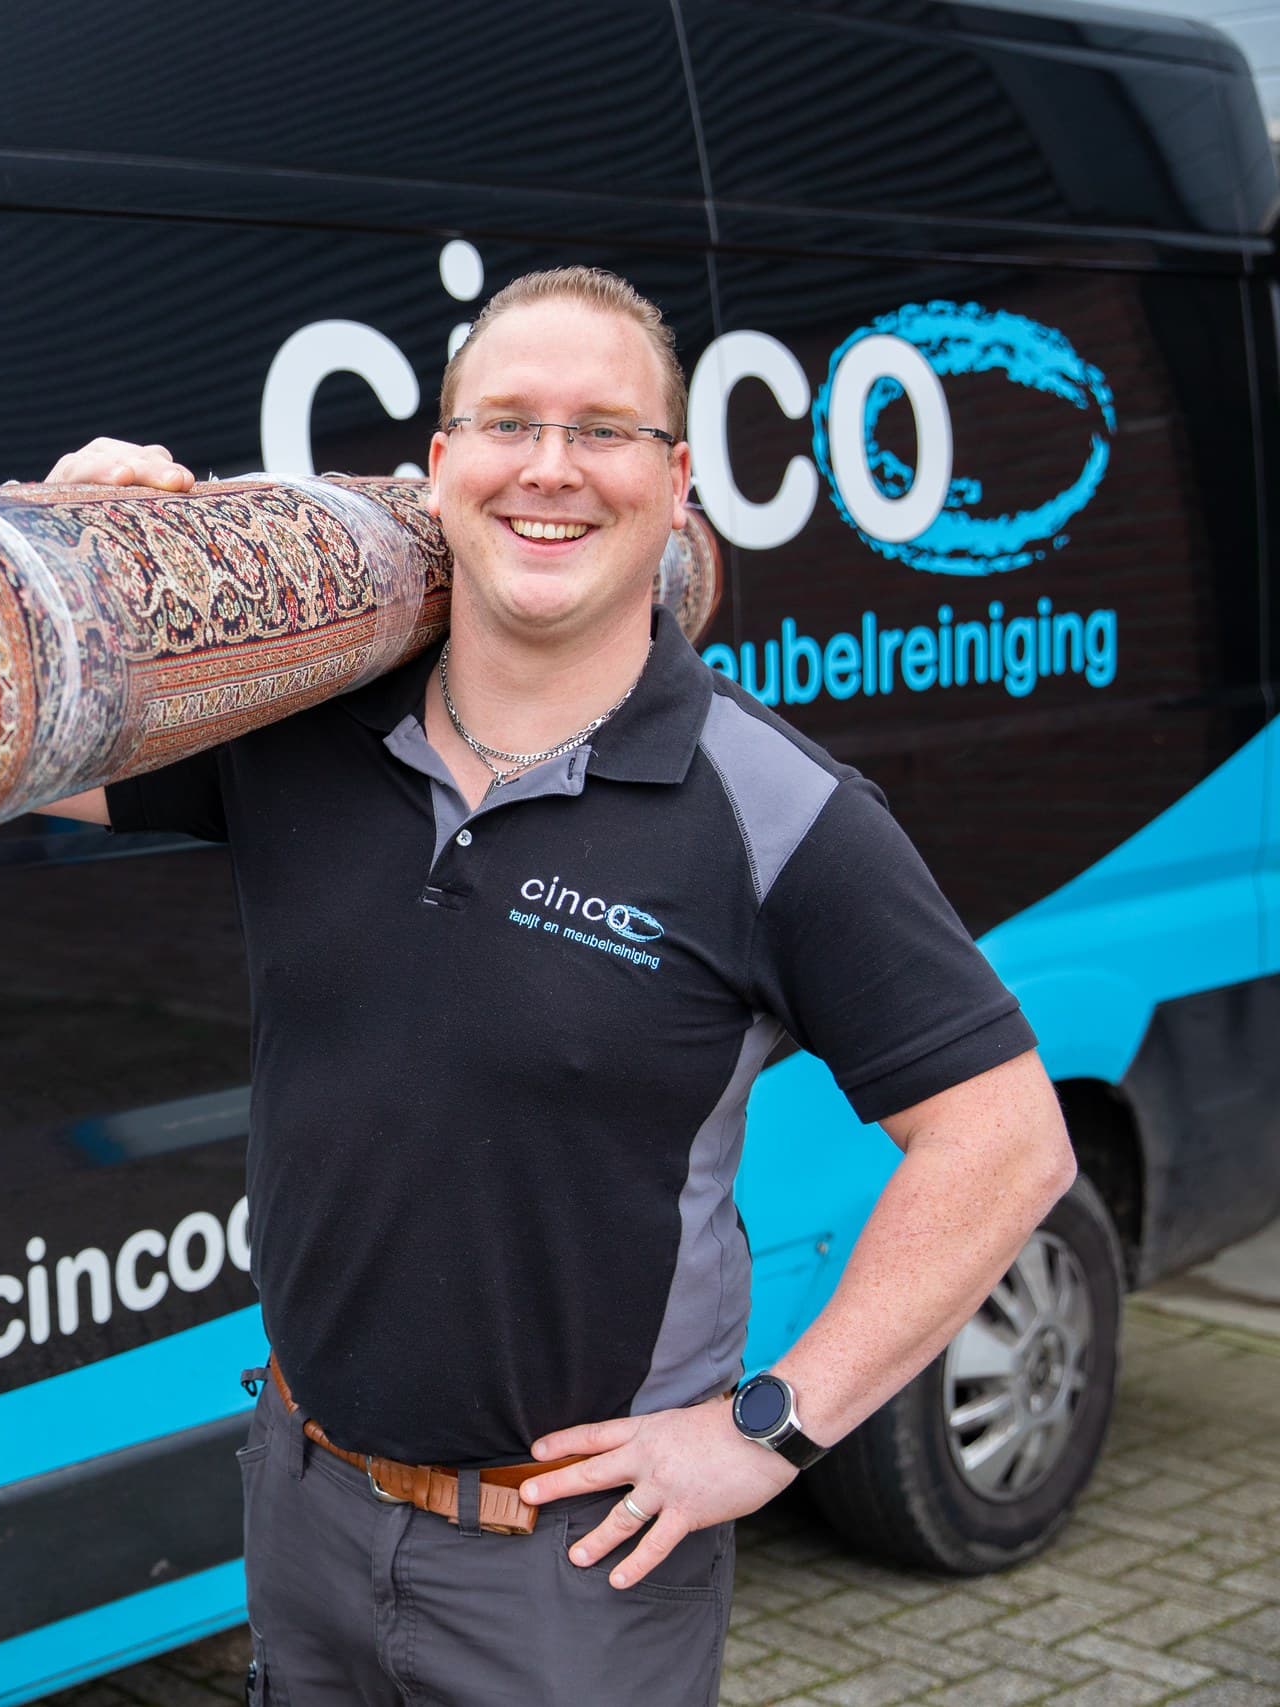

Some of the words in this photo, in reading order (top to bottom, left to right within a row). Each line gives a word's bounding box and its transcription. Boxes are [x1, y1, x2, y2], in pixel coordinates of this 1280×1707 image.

[261, 239, 953, 550] cco
[701, 595, 1117, 707] eubelreiniging
[508, 908, 540, 929] tapijt
[543, 921, 559, 934] en
[562, 927, 660, 969] meubelreiniging
[520, 876, 630, 930] cinco
